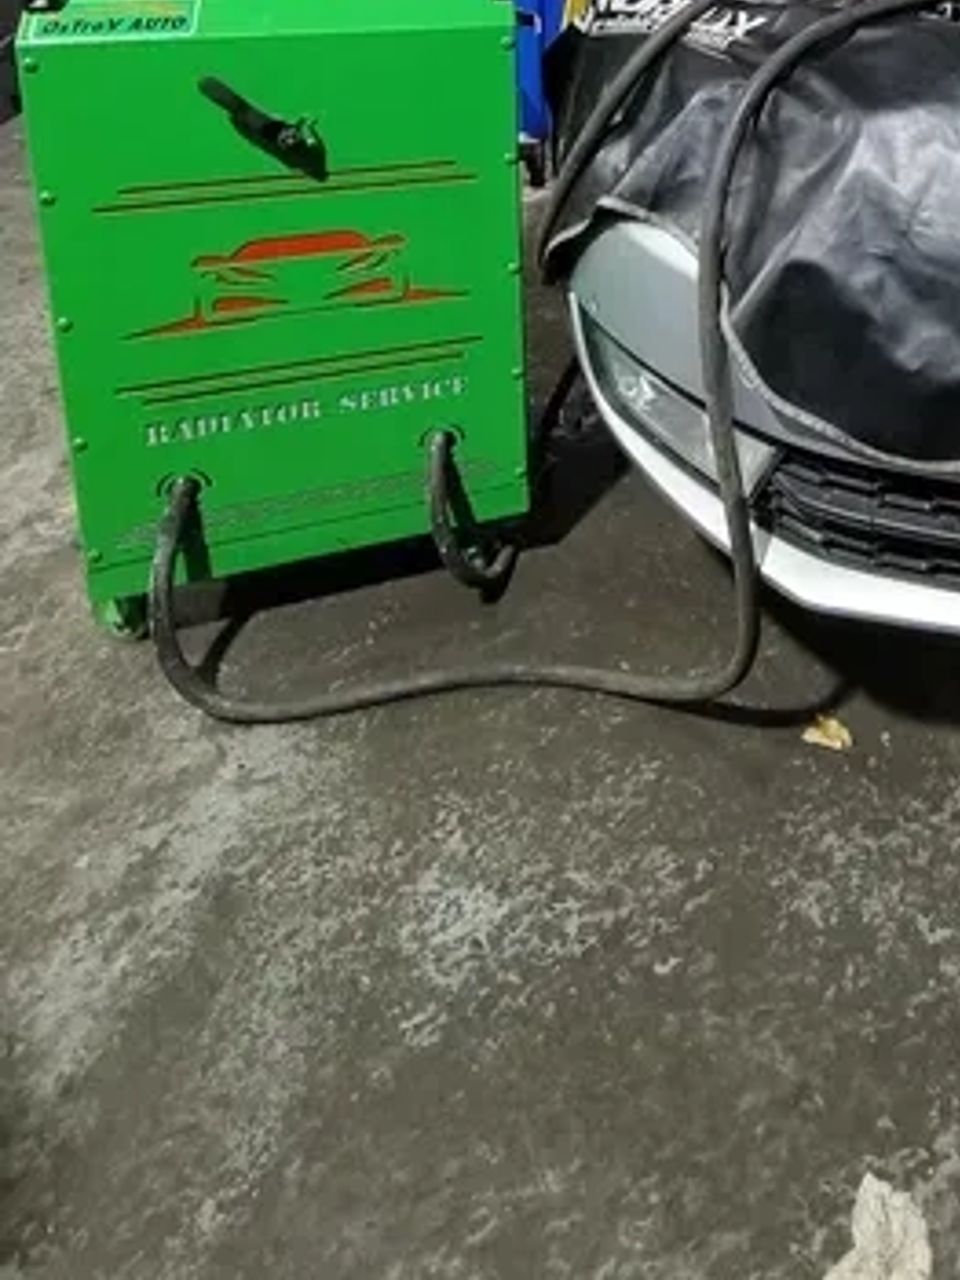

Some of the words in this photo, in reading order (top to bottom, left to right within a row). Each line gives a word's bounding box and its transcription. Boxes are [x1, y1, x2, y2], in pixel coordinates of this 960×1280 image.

[127, 15, 188, 32] AUTO
[145, 401, 321, 448] RADIATOR
[337, 376, 467, 414] SERVICE
